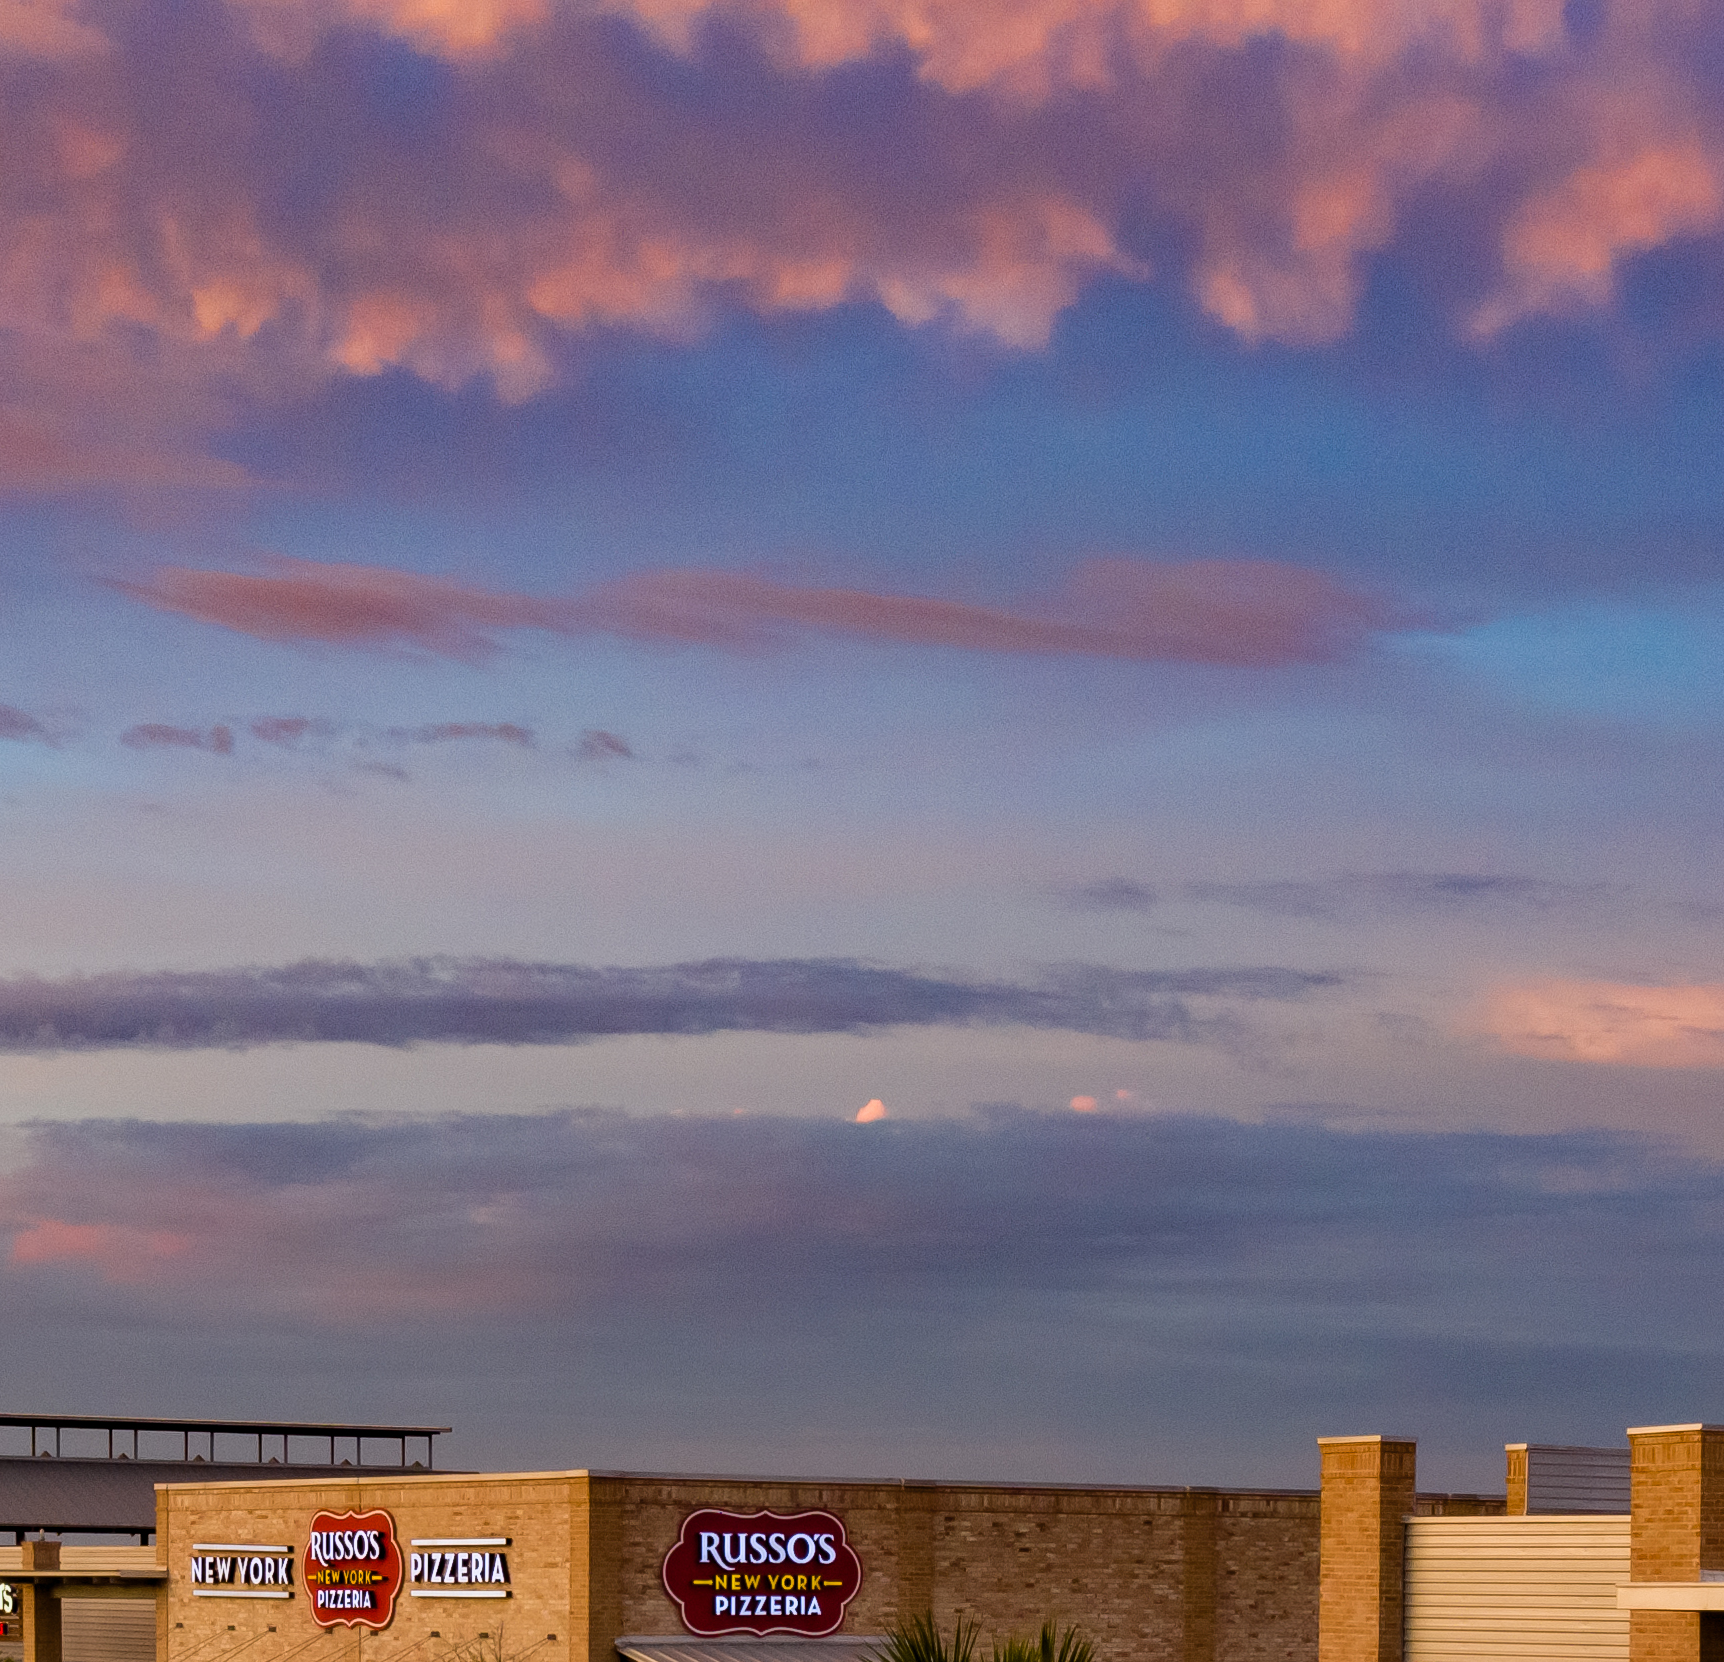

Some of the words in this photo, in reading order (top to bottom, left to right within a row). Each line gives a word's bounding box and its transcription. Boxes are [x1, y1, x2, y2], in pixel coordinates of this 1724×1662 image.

[310, 1530, 379, 1567] RUSSO'S
[699, 1531, 837, 1571] RUSSO'S
[191, 1556, 231, 1584] NEW
[238, 1557, 289, 1585] YORK
[317, 1570, 340, 1585] NEW
[343, 1570, 373, 1585] YORK
[410, 1552, 505, 1584] PIZZERIA
[715, 1574, 761, 1590] NEW
[768, 1575, 822, 1591] YORK
[317, 1590, 371, 1609] PIZZERIA
[715, 1596, 822, 1616] PIZZERIA
